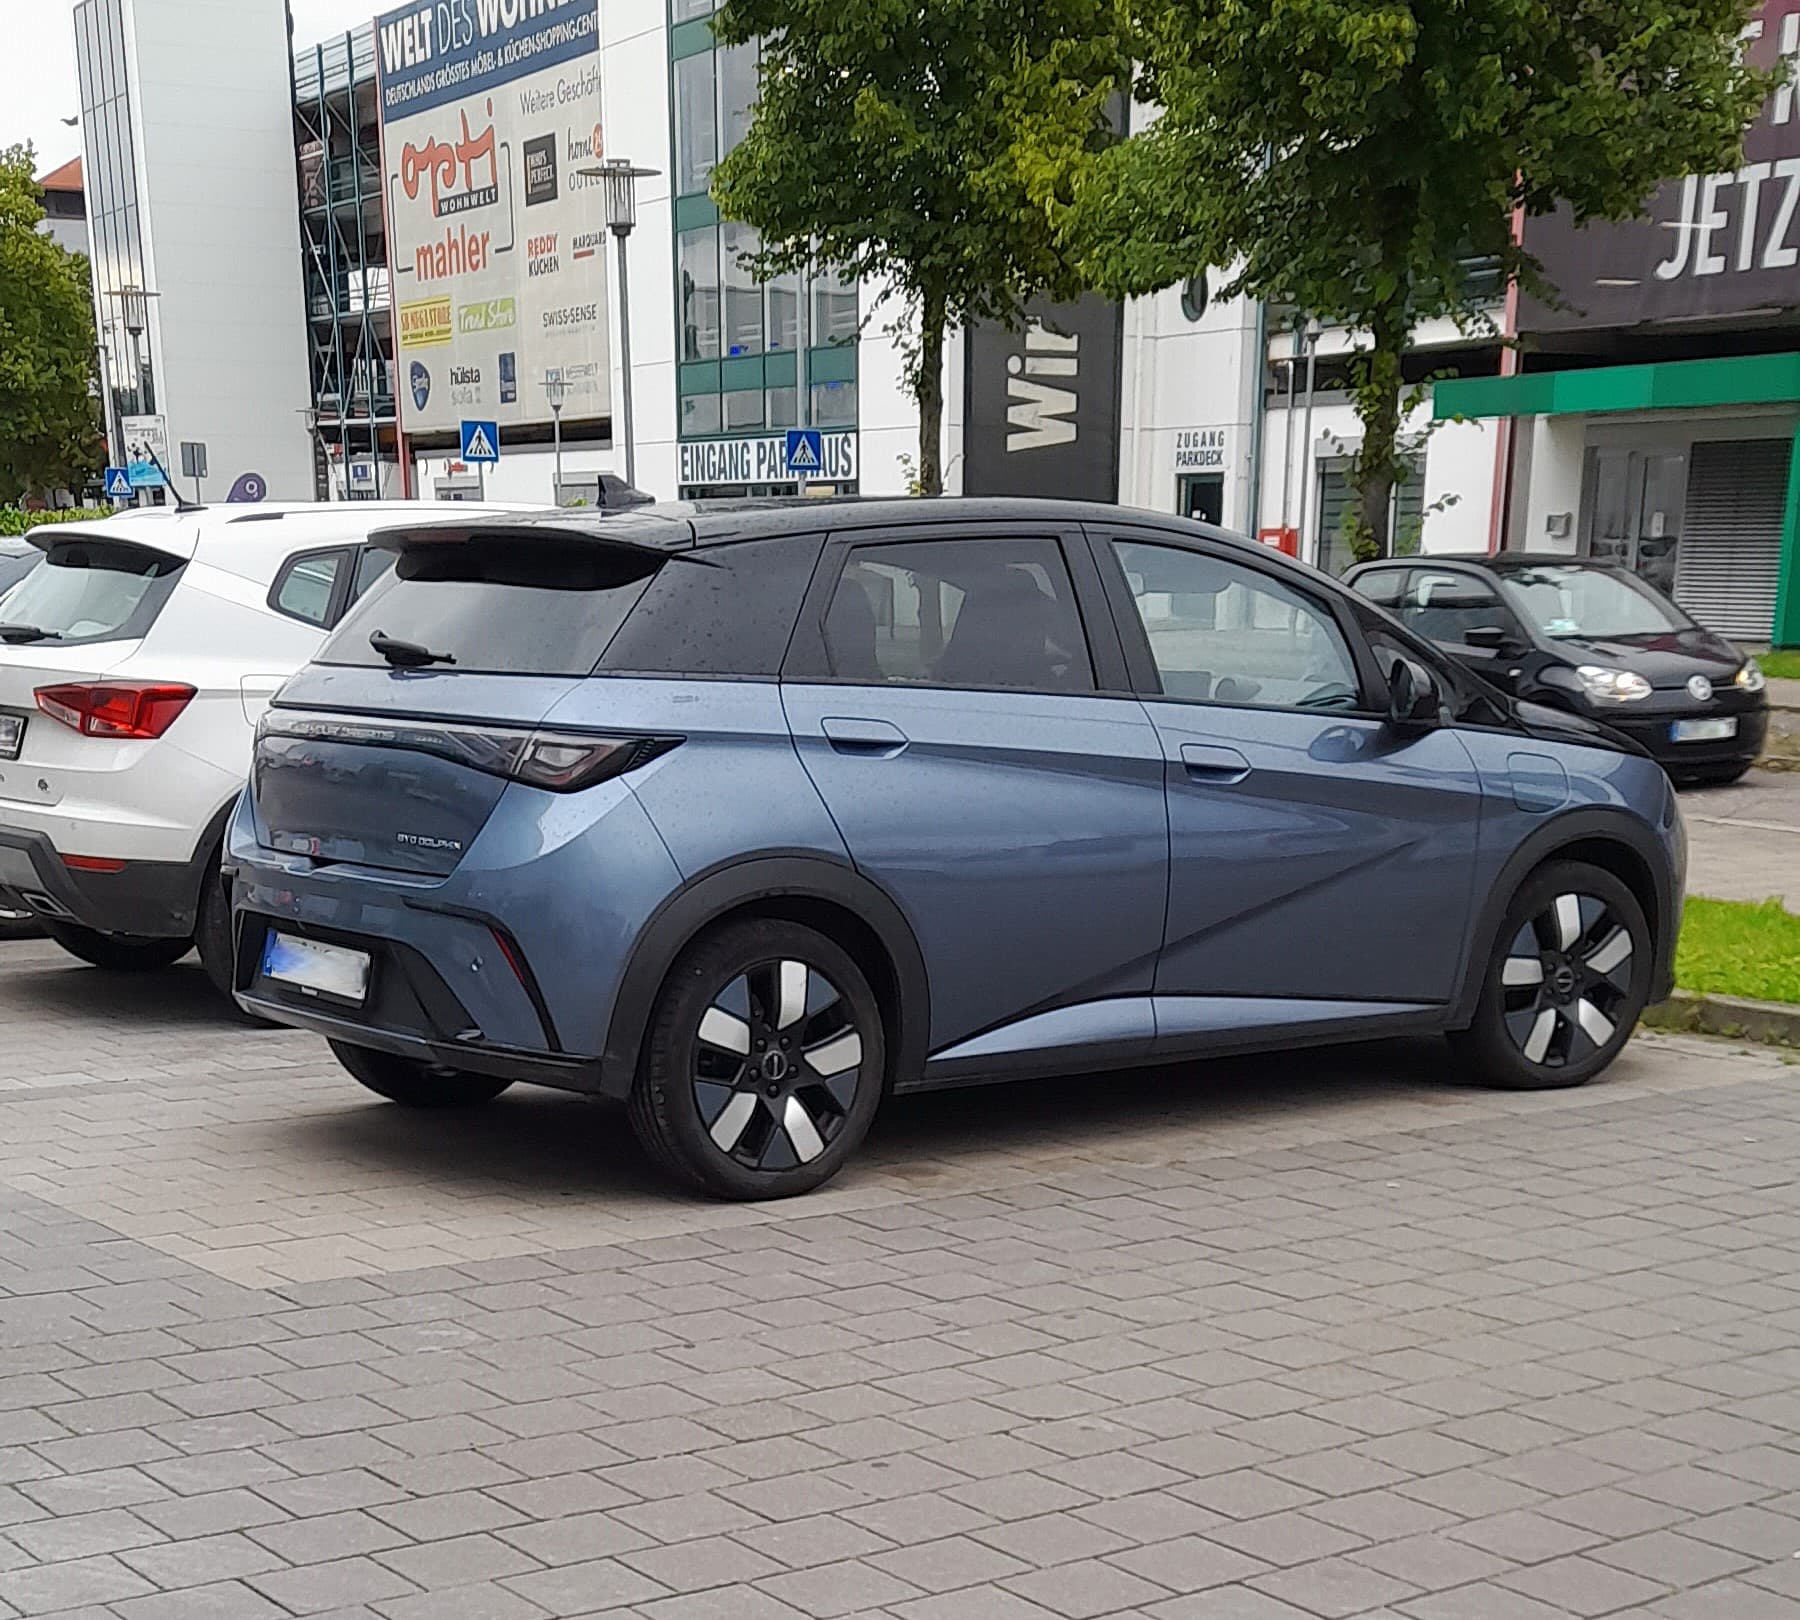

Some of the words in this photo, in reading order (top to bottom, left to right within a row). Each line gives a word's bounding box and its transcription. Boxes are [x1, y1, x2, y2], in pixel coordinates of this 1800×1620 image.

[380, 8, 432, 74] WELT
[438, 0, 473, 55] DES
[385, 71, 435, 107] DEUTSCHLANDS
[435, 61, 470, 90] GRÖSSTES
[520, 88, 555, 116] Weitere
[402, 97, 497, 217] opti
[440, 189, 497, 211] WOHNWELT
[1655, 157, 1800, 280] JETZ
[416, 224, 490, 281] mahler
[528, 233, 558, 258] REDDY
[529, 255, 559, 277] KÜCHEN
[449, 366, 480, 385] hülsta
[1007, 316, 1078, 452] Wir
[1176, 431, 1224, 448] ZUGANG
[680, 442, 750, 481] EINGANG
[756, 436, 852, 480] PARAUS
[1176, 450, 1223, 467] PARKDECK
